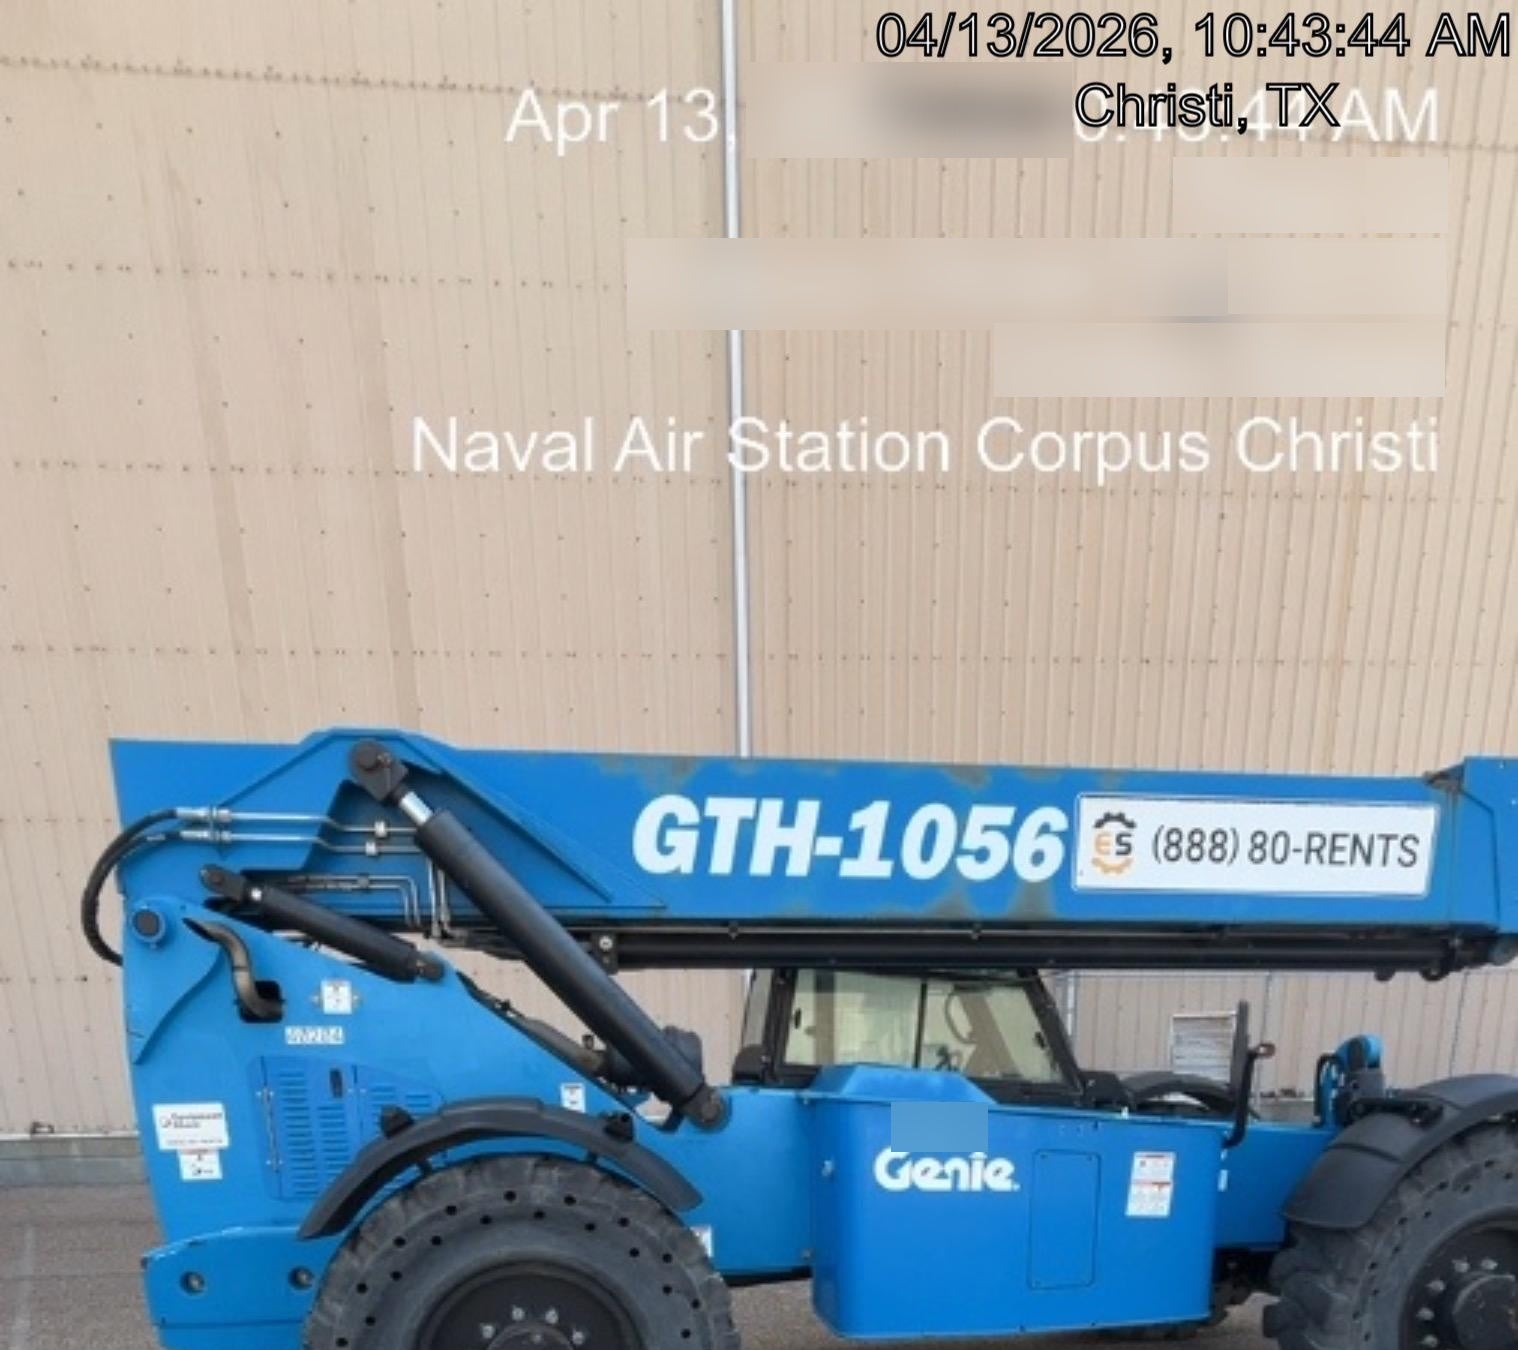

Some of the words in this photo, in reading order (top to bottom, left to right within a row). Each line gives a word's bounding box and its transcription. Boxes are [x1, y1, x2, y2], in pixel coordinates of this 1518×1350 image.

[632, 794, 1068, 883] GTH-1056
[1152, 825, 1240, 866] (888)
[1248, 830, 1420, 868] 80-RENTS
[874, 1146, 1016, 1192] Genie
